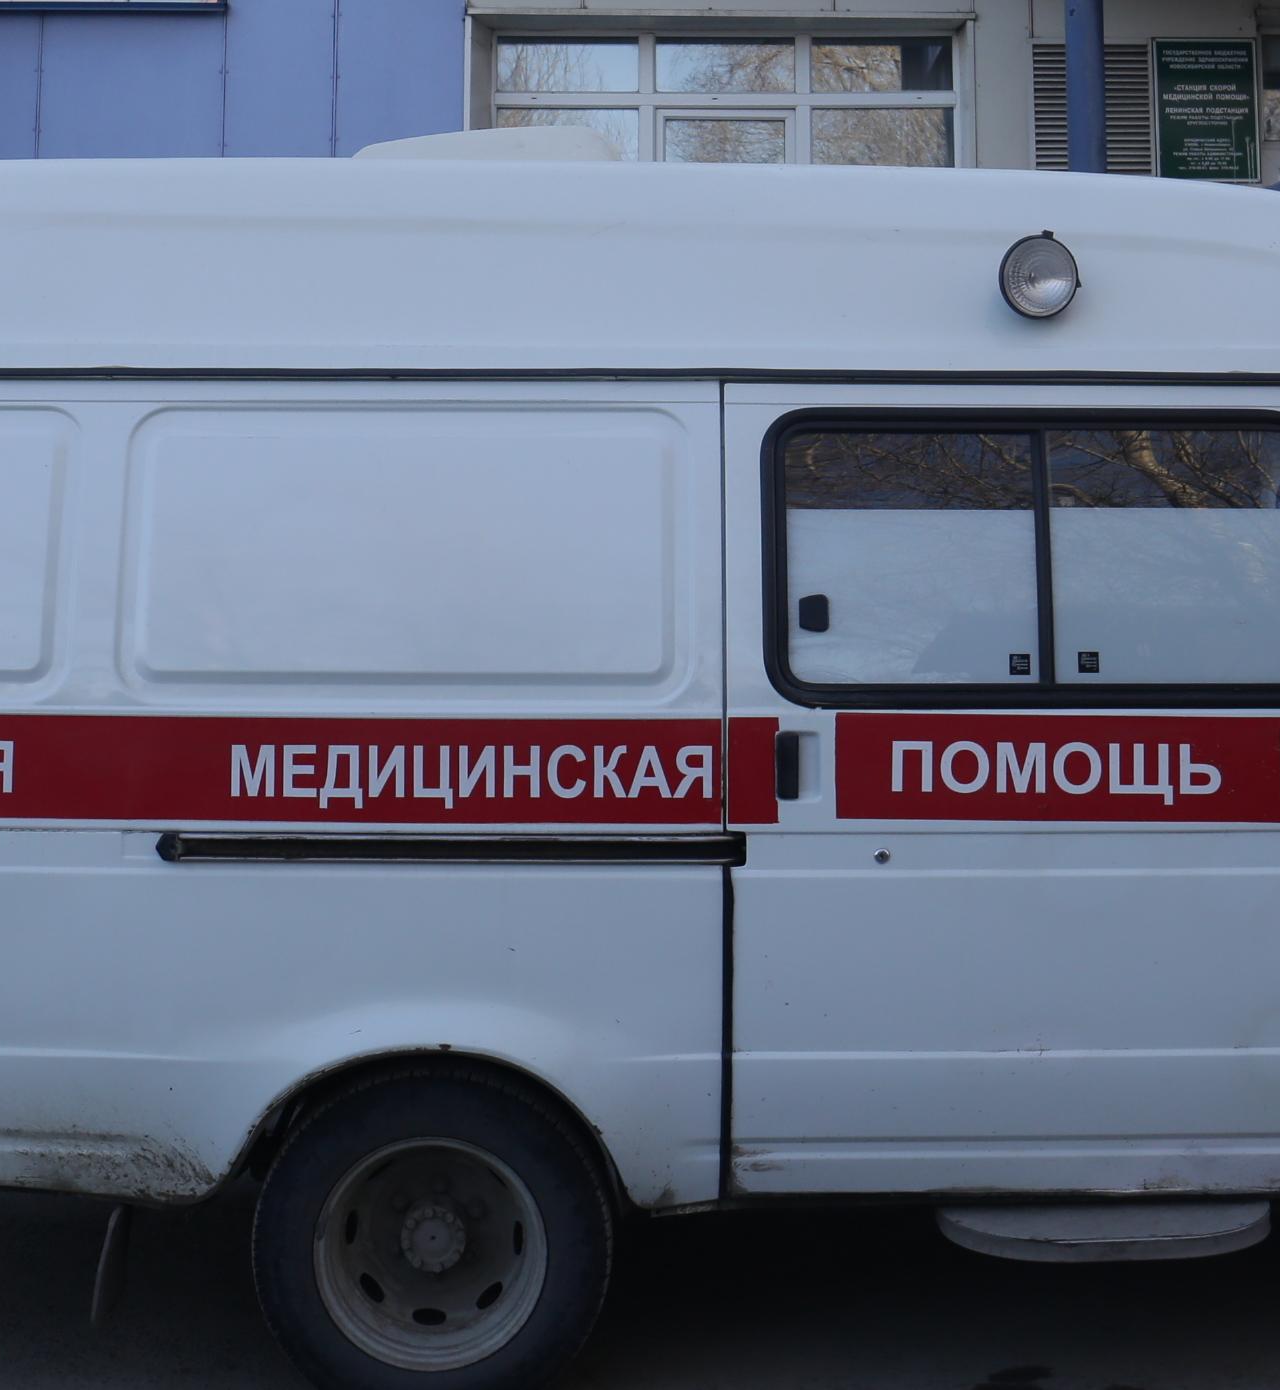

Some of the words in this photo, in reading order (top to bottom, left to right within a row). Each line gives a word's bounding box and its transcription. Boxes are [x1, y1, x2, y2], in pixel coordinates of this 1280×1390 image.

[1163, 93, 1213, 101] МЕДИЦИНСКОЙ
[230, 743, 714, 809] МЕДИЦИНСКАЯ
[891, 740, 1222, 806] ПОМОЩЬ
